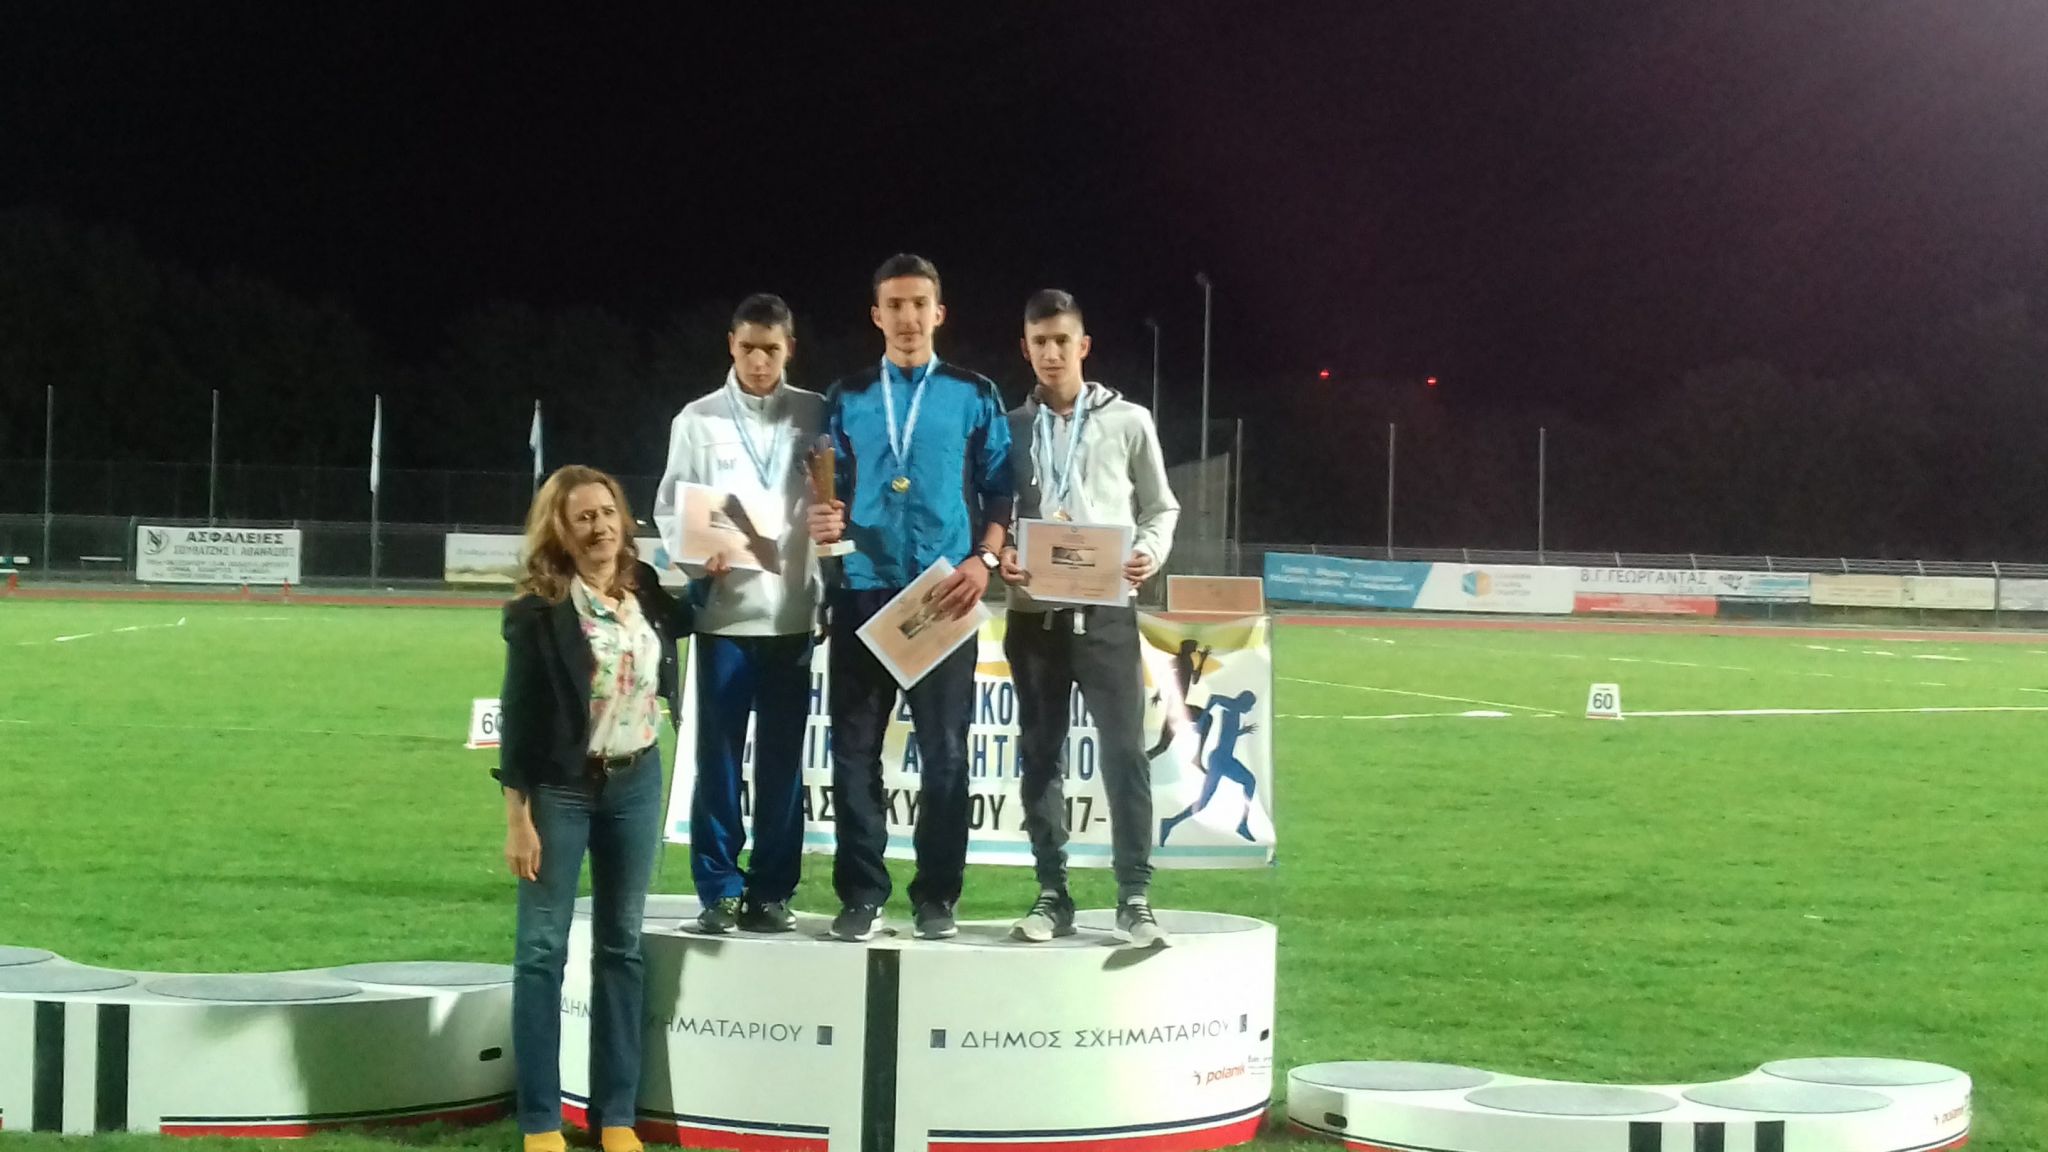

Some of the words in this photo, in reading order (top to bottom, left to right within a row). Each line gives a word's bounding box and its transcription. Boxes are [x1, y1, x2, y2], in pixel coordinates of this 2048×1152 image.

[186, 531, 283, 544] ΑΣΦΑΛΕΙΕΣ
[1593, 692, 1613, 710] 60
[961, 1029, 1063, 1049] ΔΗΜΟΣ
[1074, 1020, 1229, 1048] ΣΧΗΜΑΤΑΡΙΟΥ
[1205, 1063, 1245, 1086] polanik
